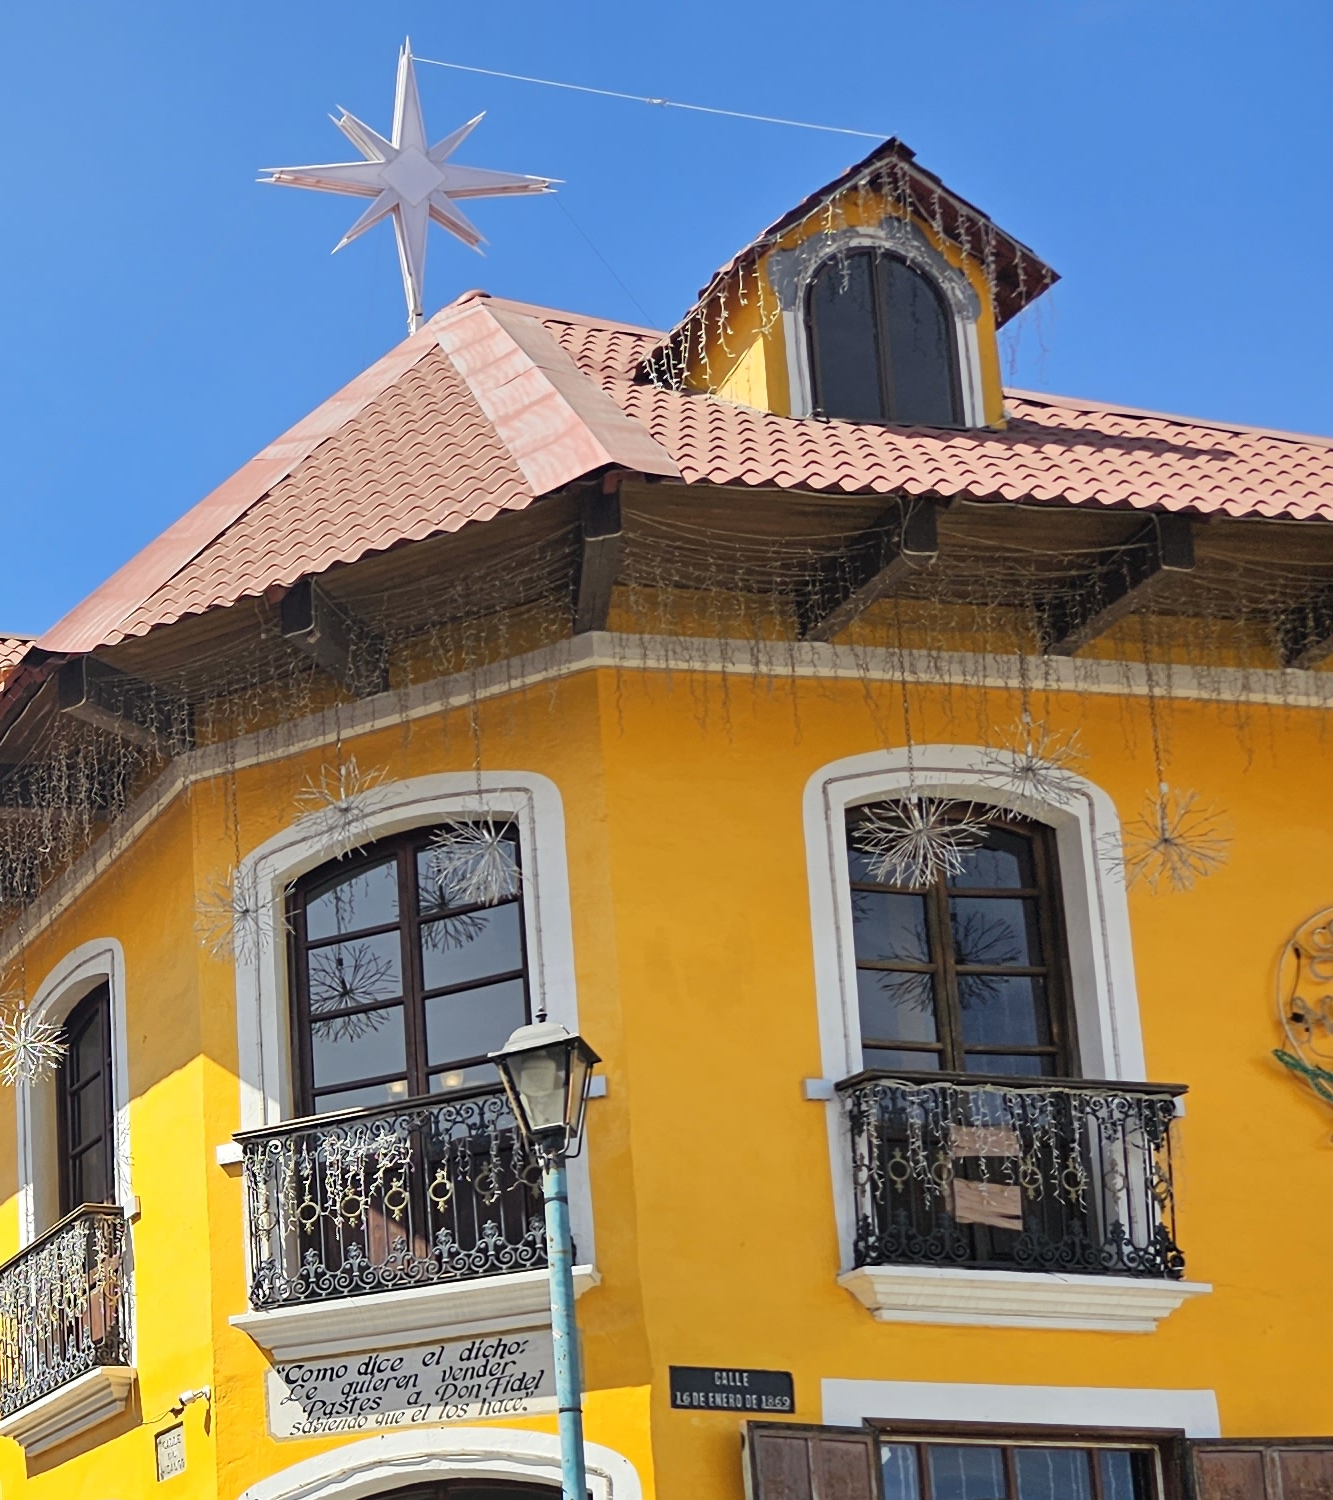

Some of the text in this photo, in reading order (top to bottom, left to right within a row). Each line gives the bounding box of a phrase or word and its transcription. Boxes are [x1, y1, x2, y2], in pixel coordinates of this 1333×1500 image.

[357, 1353, 404, 1377] dice
[422, 1345, 445, 1368] el
[341, 1372, 419, 1399] quieren
[441, 1358, 517, 1383] vender
[714, 1371, 749, 1387] CALLE
[302, 1395, 383, 1421] Pastes
[406, 1390, 423, 1406] a
[435, 1381, 482, 1404] Don
[676, 1391, 791, 1410] 16 DE ENERO DE 1869
[374, 1411, 406, 1426] que
[438, 1403, 468, 1420] los
